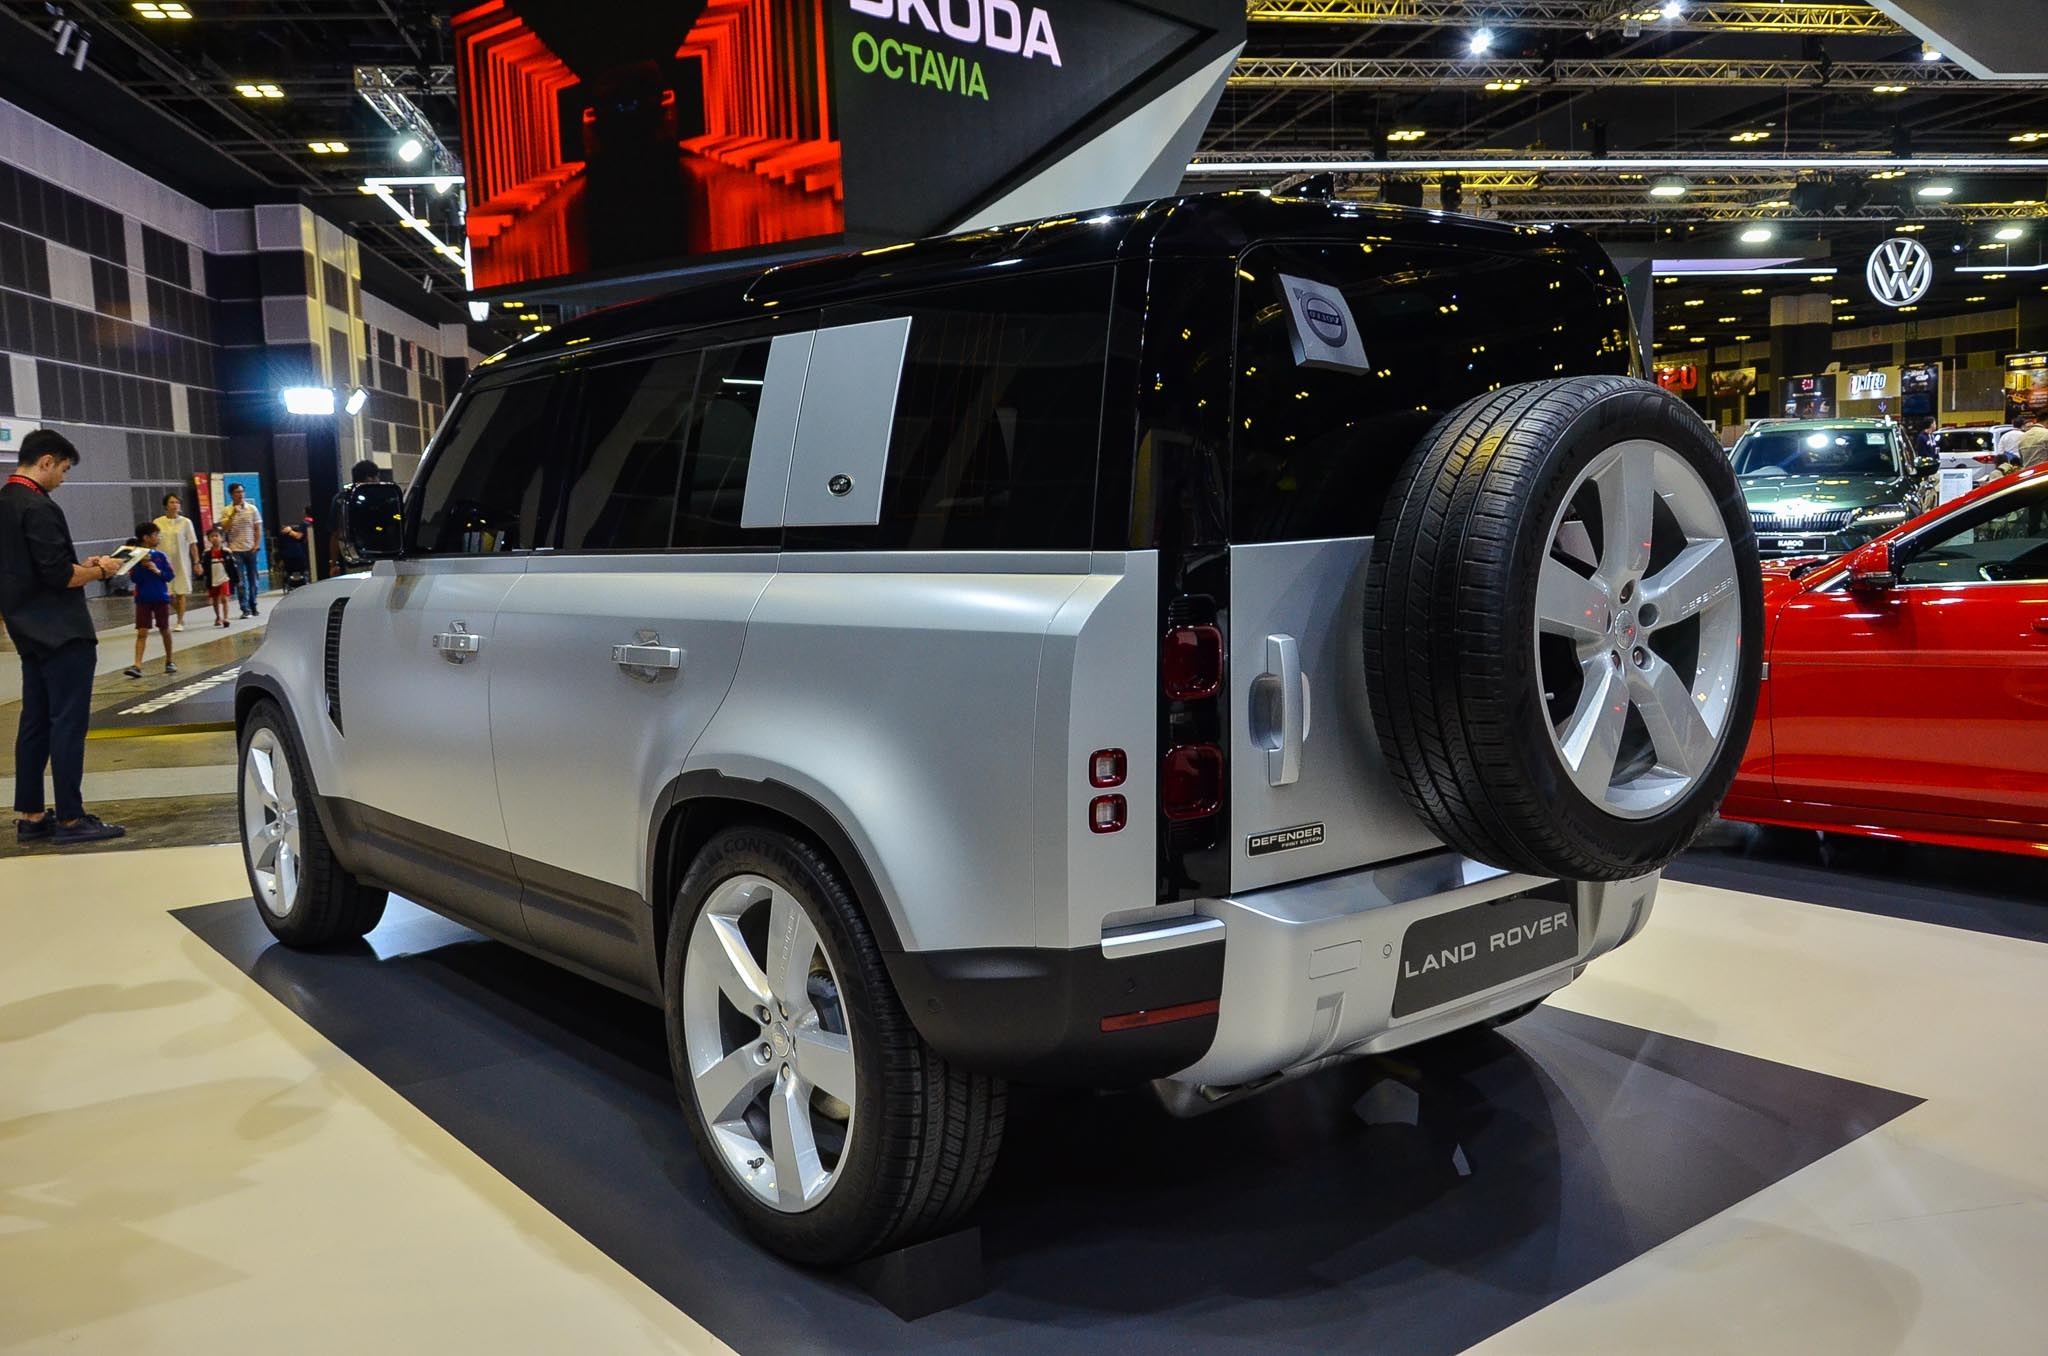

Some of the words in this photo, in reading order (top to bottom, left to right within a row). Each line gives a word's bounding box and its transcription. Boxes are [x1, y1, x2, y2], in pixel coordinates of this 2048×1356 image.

[852, 31, 989, 100] OCTAVIA
[1251, 827, 1322, 847] DEFENDER
[1405, 941, 1476, 978] LAND
[1490, 911, 1568, 952] ROVER
